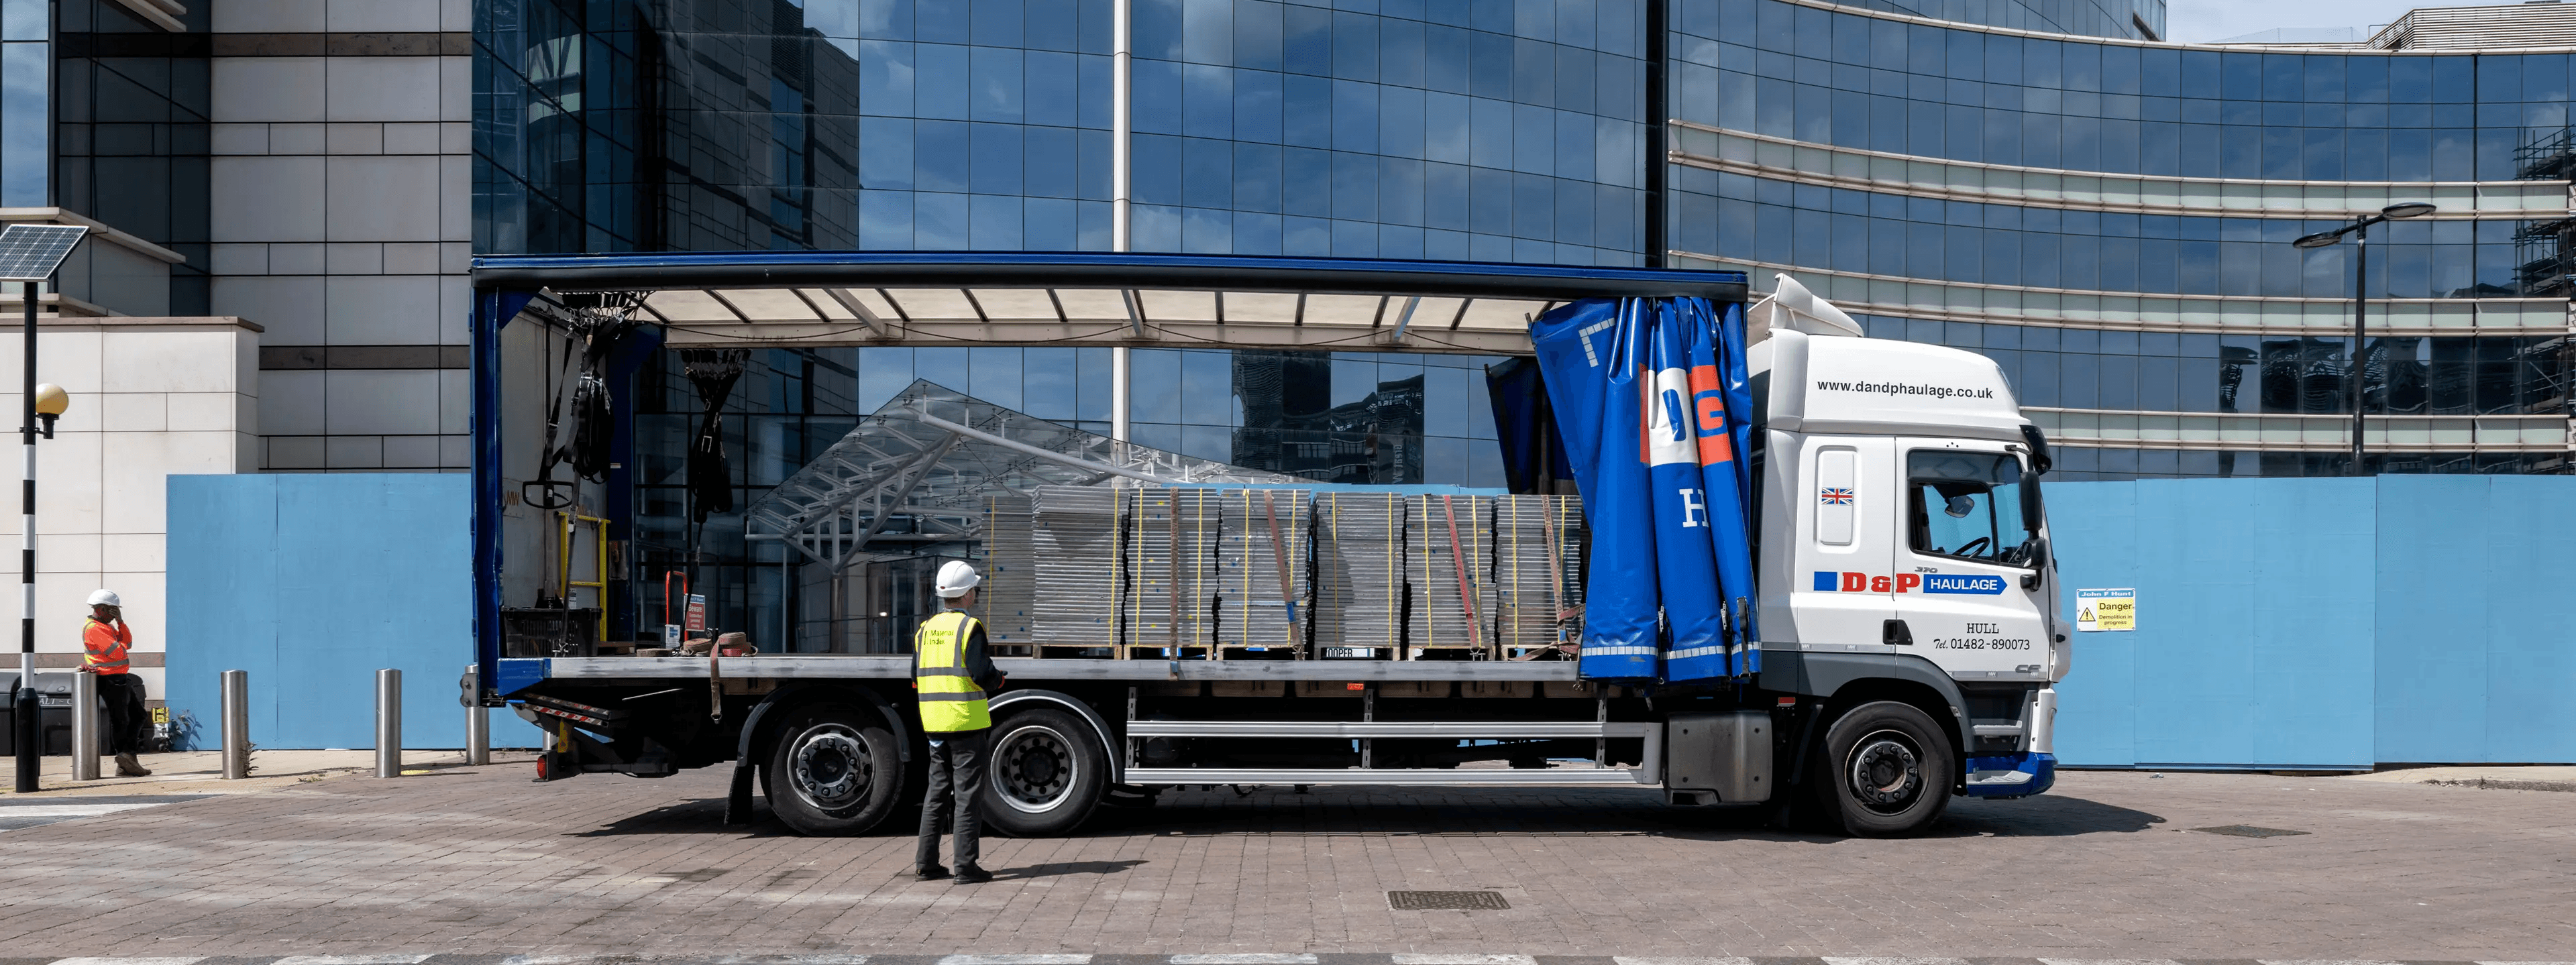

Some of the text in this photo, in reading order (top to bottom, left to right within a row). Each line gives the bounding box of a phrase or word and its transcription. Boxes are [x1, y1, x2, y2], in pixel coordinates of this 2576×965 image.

[1817, 381, 1993, 399] www.dandphaulage.co.uk
[1841, 571, 1998, 593] D&P HAULAGE
[2099, 603, 2132, 612] Danger
[1967, 623, 1999, 634] HULL
[1933, 638, 2030, 650] Tel. 01482-890073
